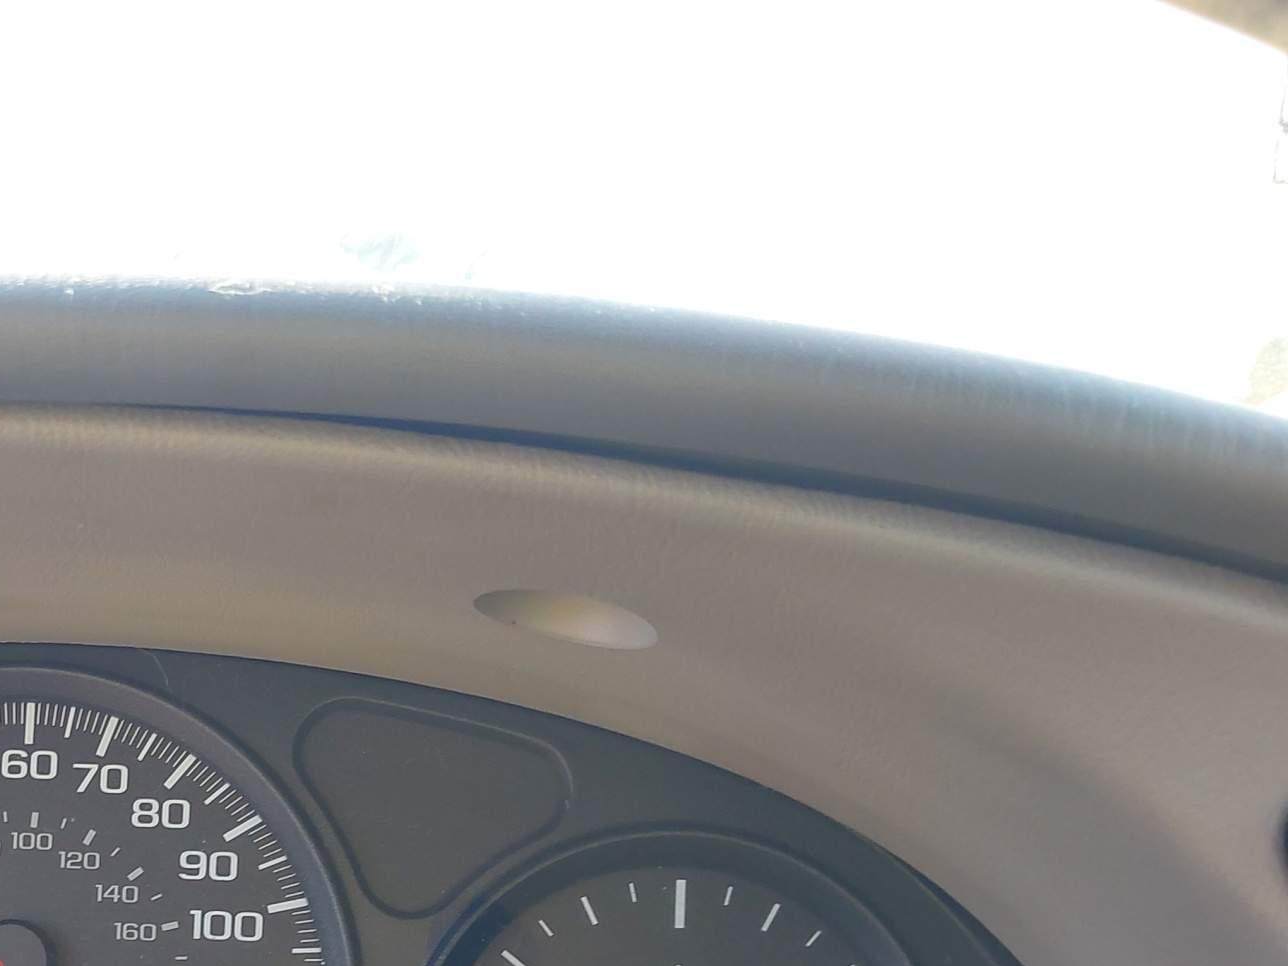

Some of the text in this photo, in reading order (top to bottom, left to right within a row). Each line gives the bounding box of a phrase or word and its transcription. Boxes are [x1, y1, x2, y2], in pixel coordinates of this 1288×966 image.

[1, 750, 59, 780] 60
[73, 764, 129, 794] 70
[130, 799, 191, 829] 80
[11, 832, 53, 851] 100
[58, 851, 101, 870] 120
[178, 851, 239, 881] 90
[95, 884, 140, 903] 140
[113, 922, 158, 941] 160
[189, 911, 264, 941] 100
